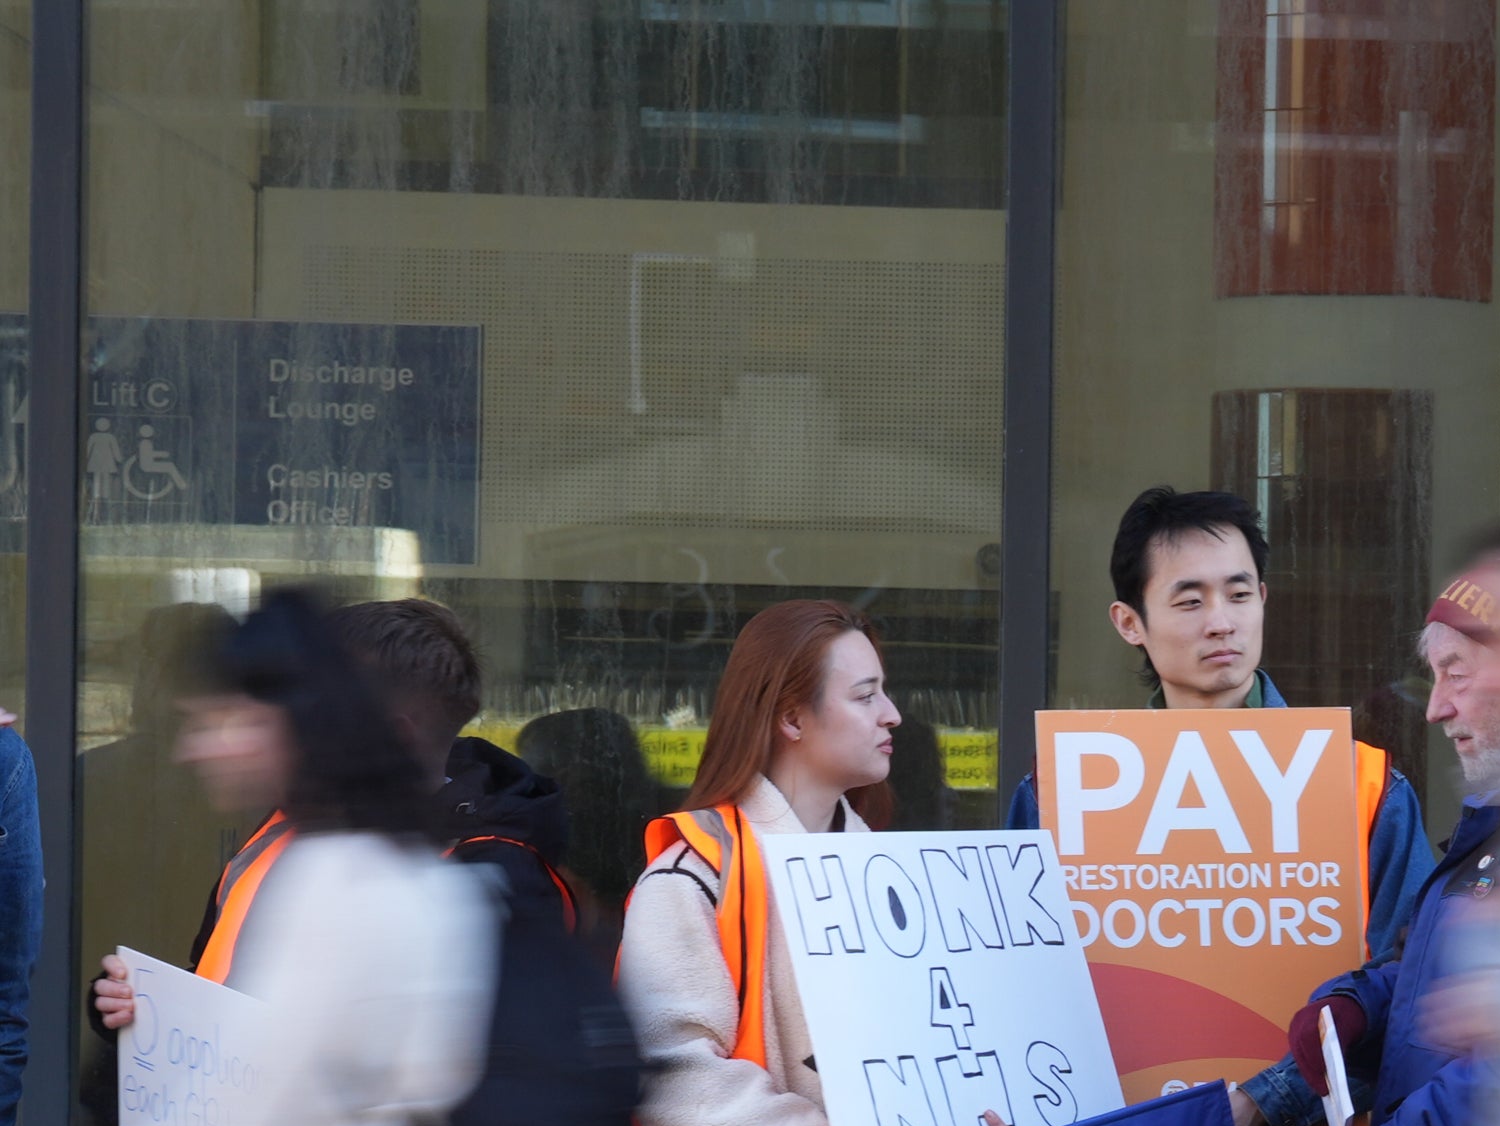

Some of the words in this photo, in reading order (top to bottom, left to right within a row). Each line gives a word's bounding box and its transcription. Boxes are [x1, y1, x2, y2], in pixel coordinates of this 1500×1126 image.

[269, 359, 414, 391] Discharge
[92, 381, 138, 407] Lift
[146, 382, 170, 408] C
[268, 396, 377, 426] Lounge
[267, 464, 393, 489] Cashiers
[267, 500, 351, 526] Office
[1053, 728, 1334, 856] PAY
[1060, 863, 1272, 890] RESTORATION
[1279, 861, 1341, 888] FOR
[785, 843, 1066, 958] HONK
[929, 966, 975, 1051] 4
